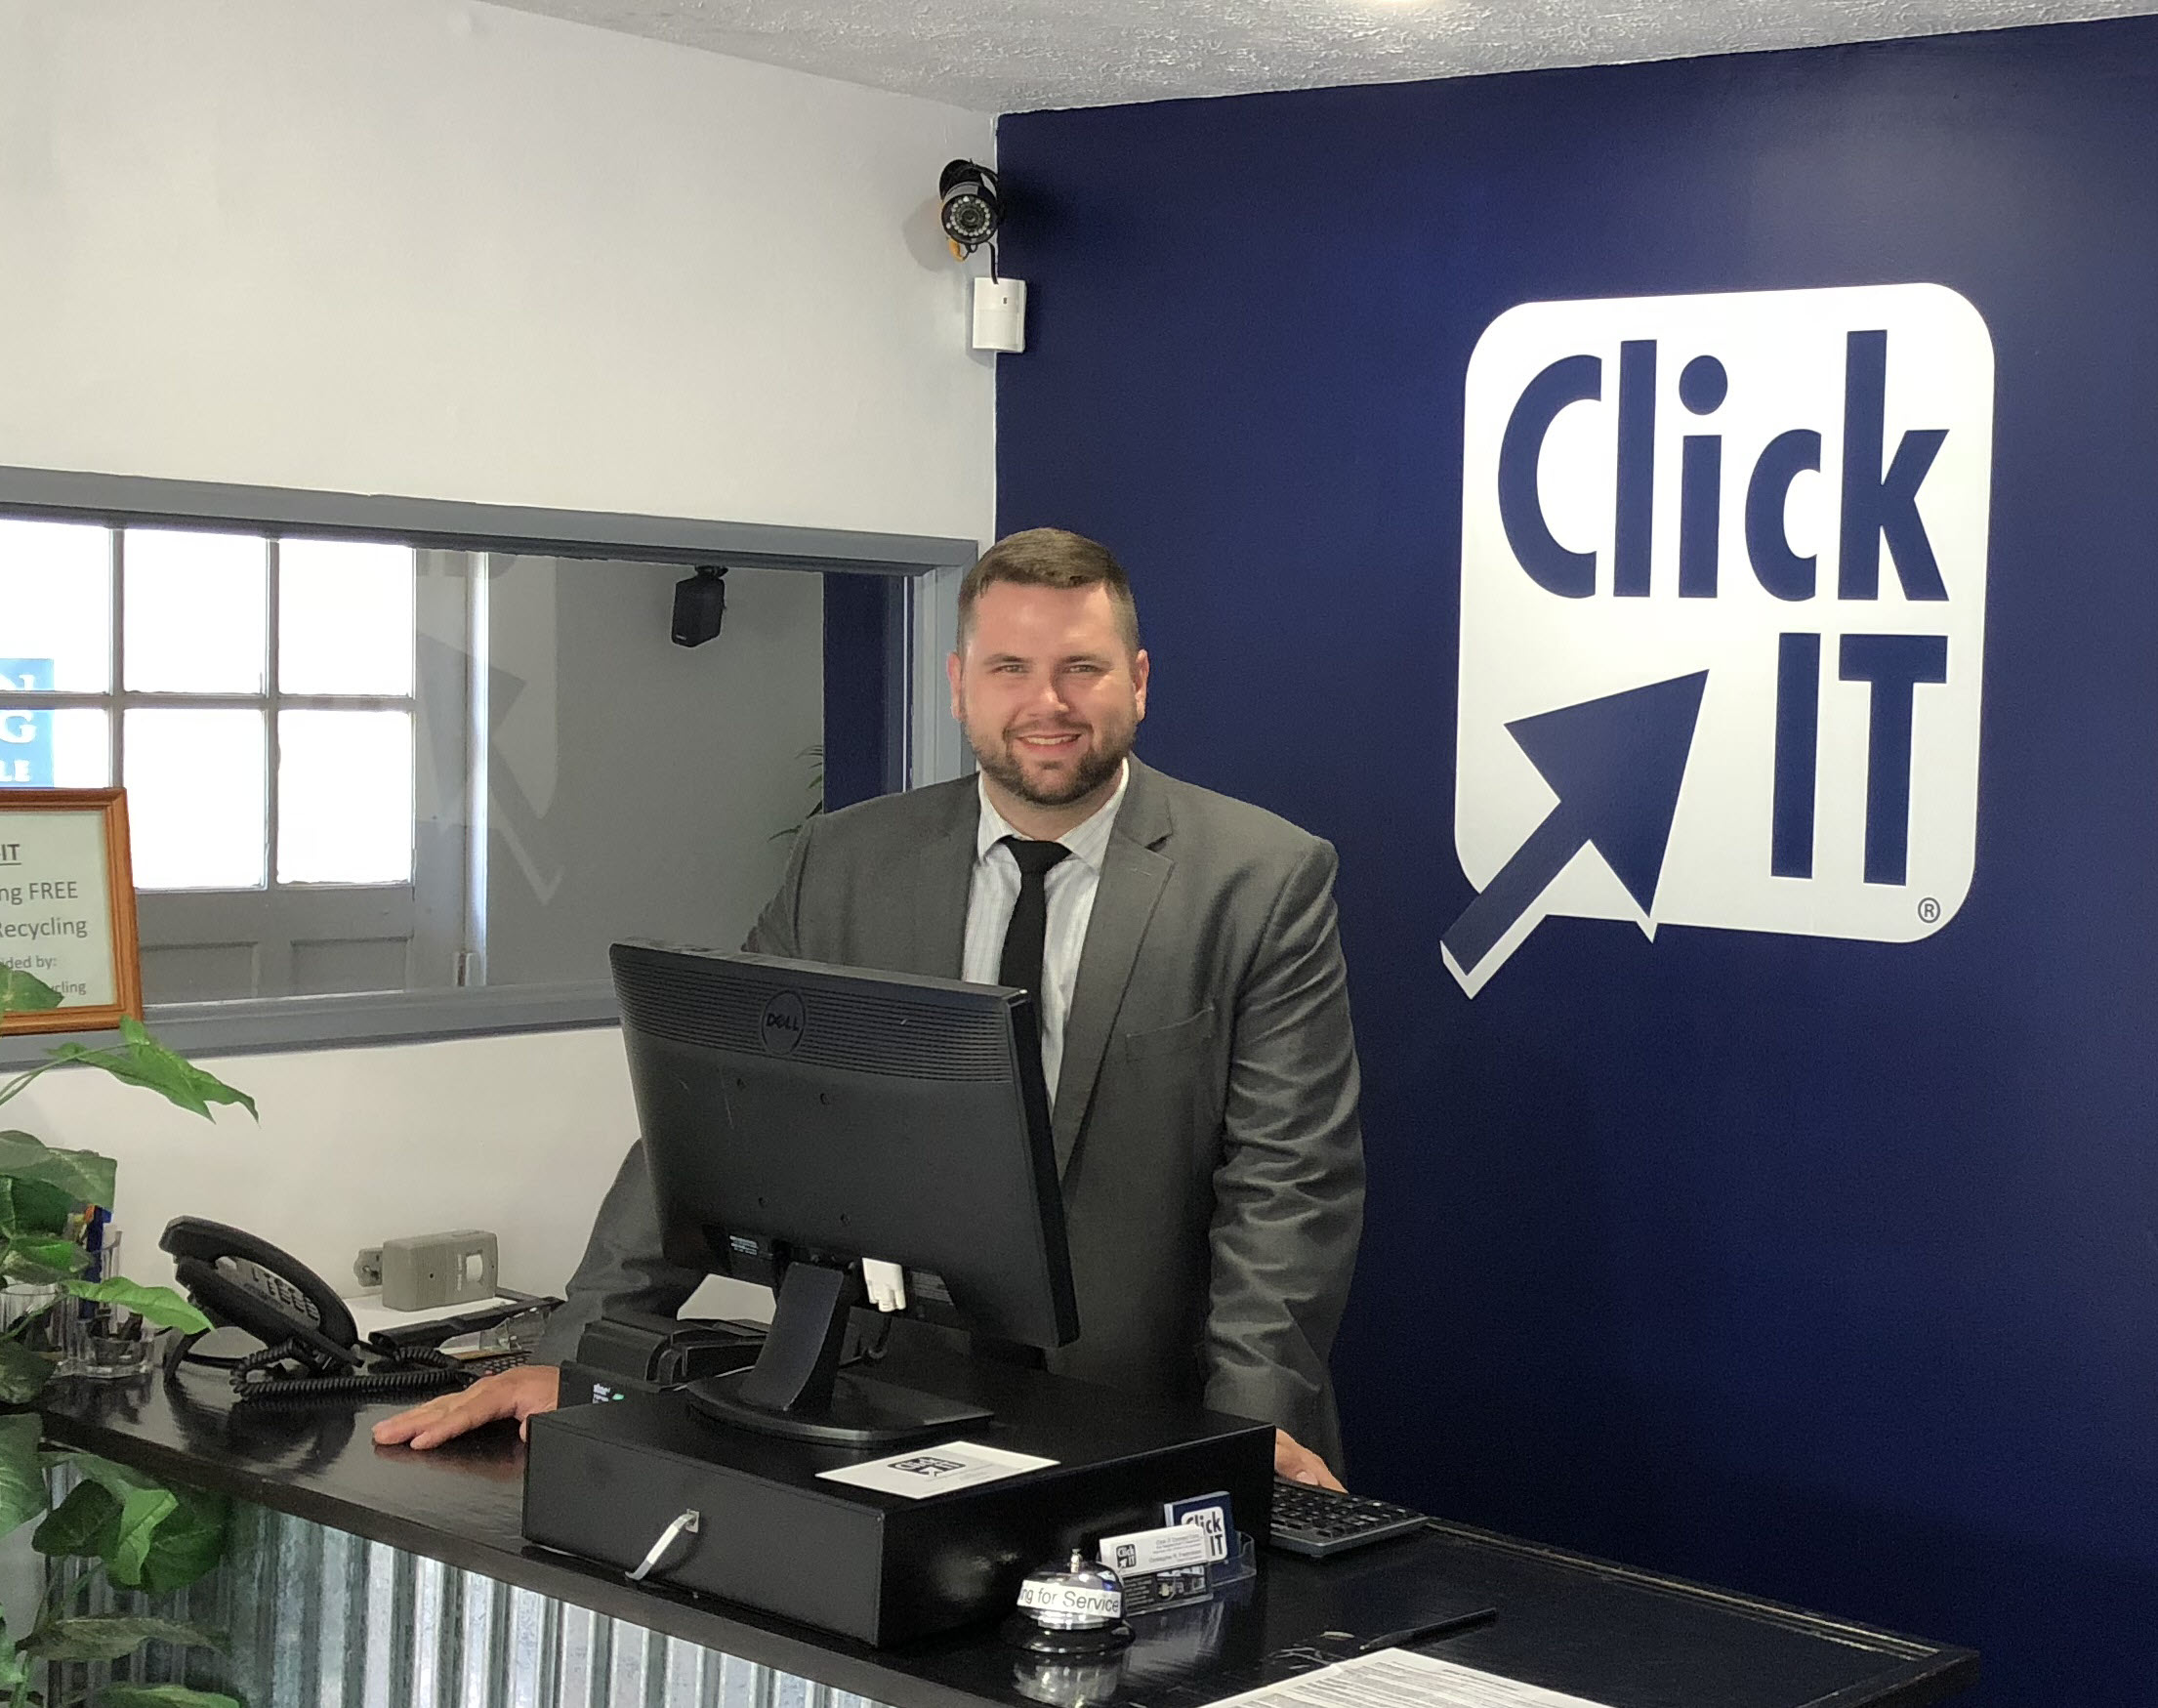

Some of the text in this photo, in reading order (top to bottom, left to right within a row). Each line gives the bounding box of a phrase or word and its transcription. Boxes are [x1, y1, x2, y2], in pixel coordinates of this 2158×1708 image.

[1497, 329, 1950, 603] Click
[1770, 632, 1949, 887] IT
[29, 881, 78, 899] FREE
[1, 956, 58, 971] ded by:
[52, 980, 87, 996] cling
[766, 1013, 800, 1032] DELL
[1210, 1534, 1224, 1557] IT
[1038, 1587, 1058, 1604] for
[1062, 1590, 1119, 1613] Service
